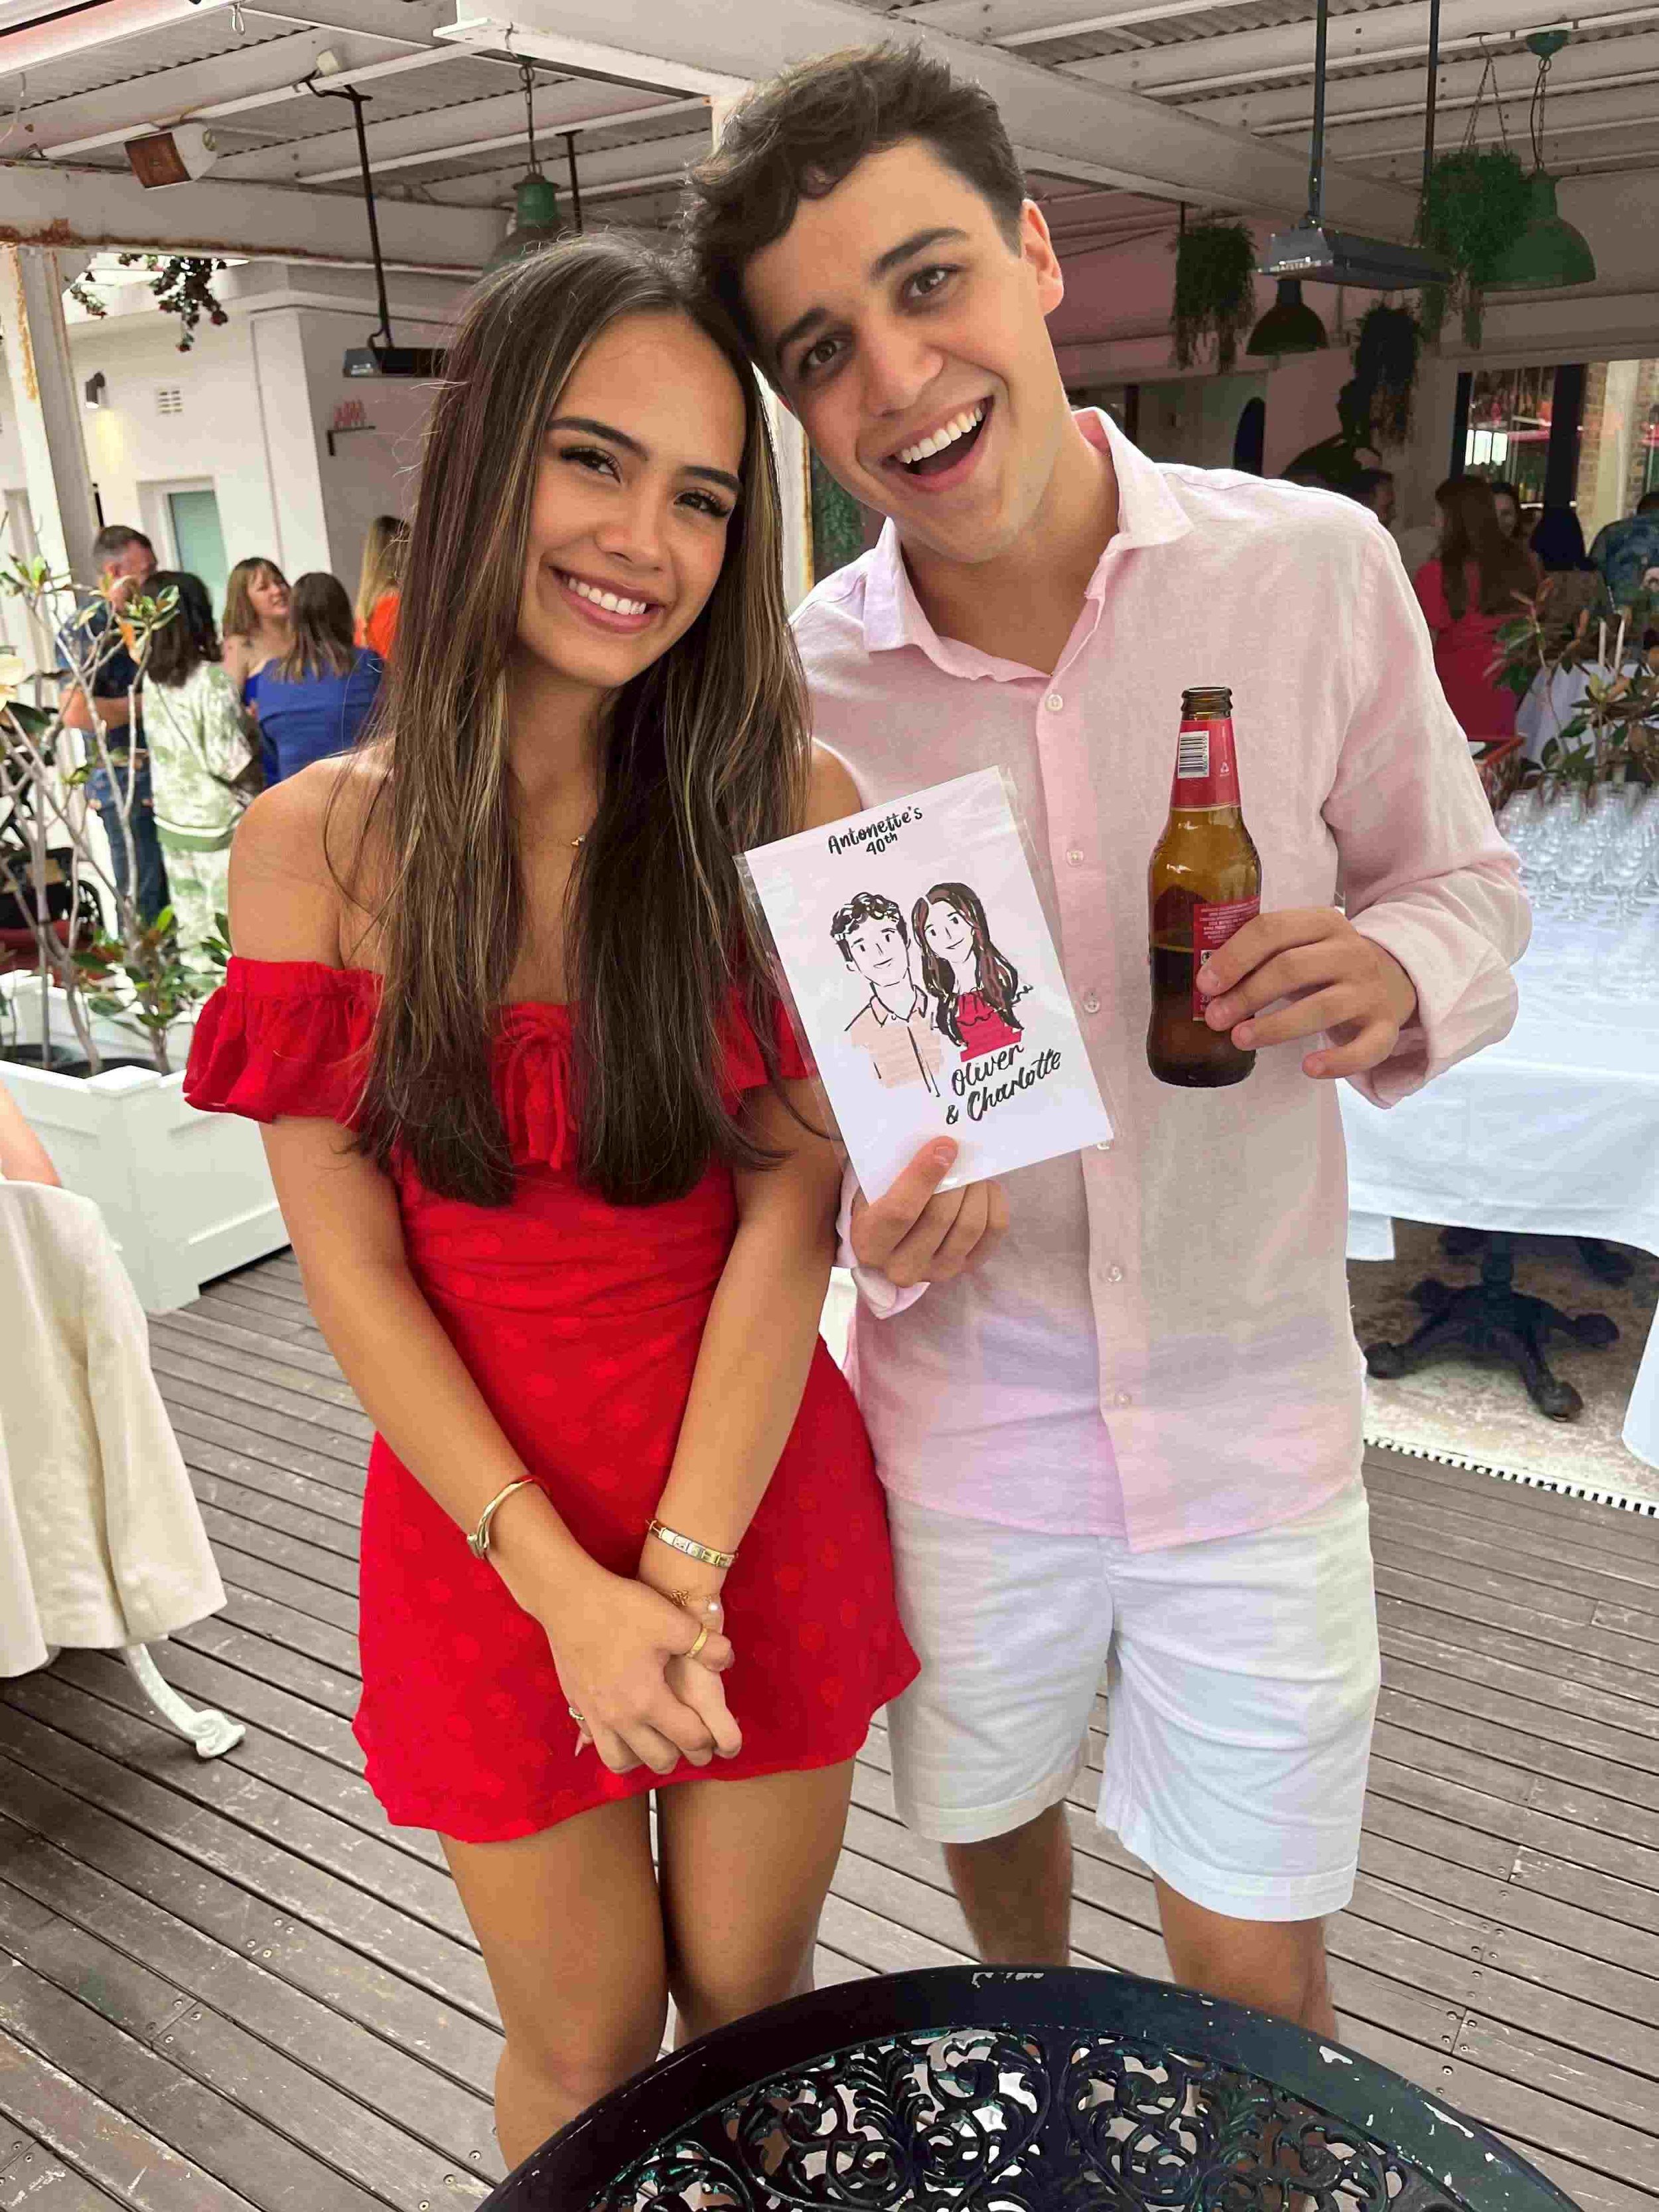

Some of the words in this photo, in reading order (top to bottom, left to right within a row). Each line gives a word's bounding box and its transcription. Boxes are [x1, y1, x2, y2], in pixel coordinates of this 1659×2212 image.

[828, 806, 922, 855] Antonette's
[866, 832, 898, 855] 40th
[946, 1104, 959, 1125] &
[967, 1049, 1062, 1121] Charlotte
[952, 1045, 1024, 1096] Oliver
